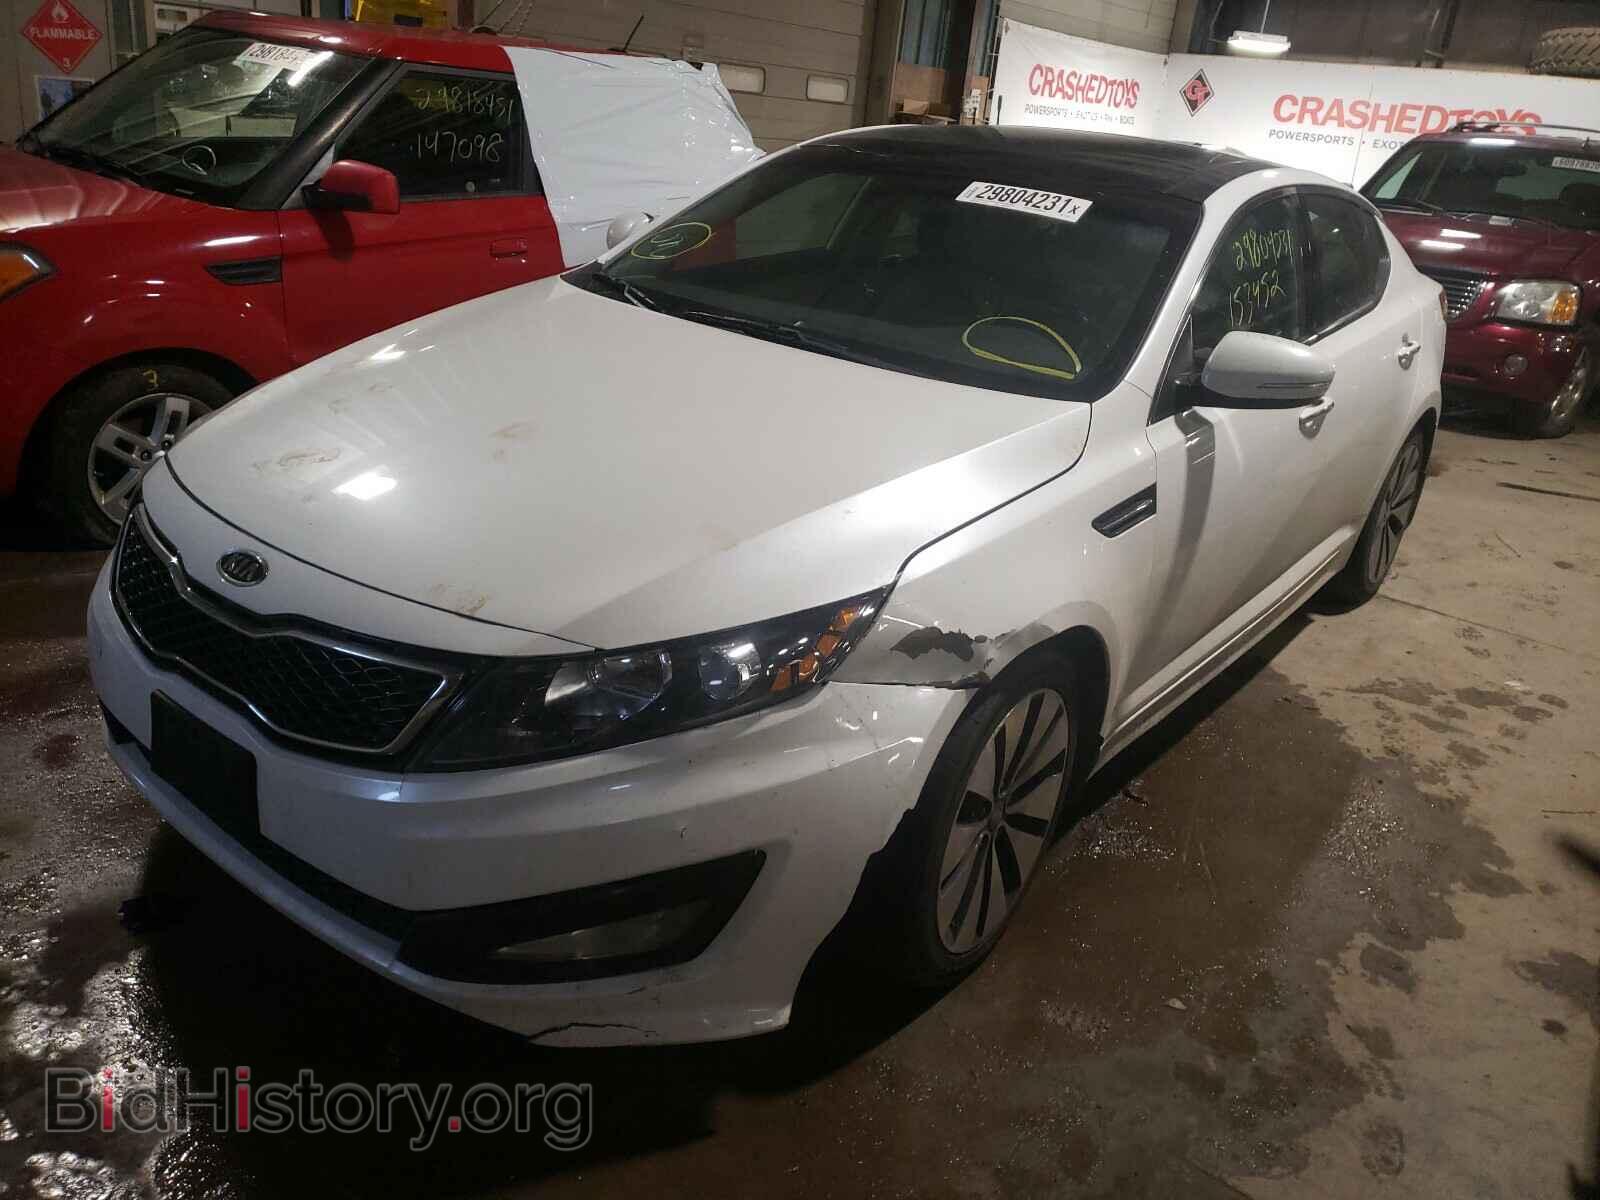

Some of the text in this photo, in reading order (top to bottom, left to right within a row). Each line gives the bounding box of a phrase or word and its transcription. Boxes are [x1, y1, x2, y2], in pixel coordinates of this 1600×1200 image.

[30, 27, 97, 40] FLAMMABLE
[62, 56, 72, 69] 3
[1028, 63, 1140, 109] CRASHEDTOYS
[418, 128, 504, 163] 147098
[1268, 128, 1354, 146] POWERSPORTS
[976, 184, 1073, 213] 29804231
